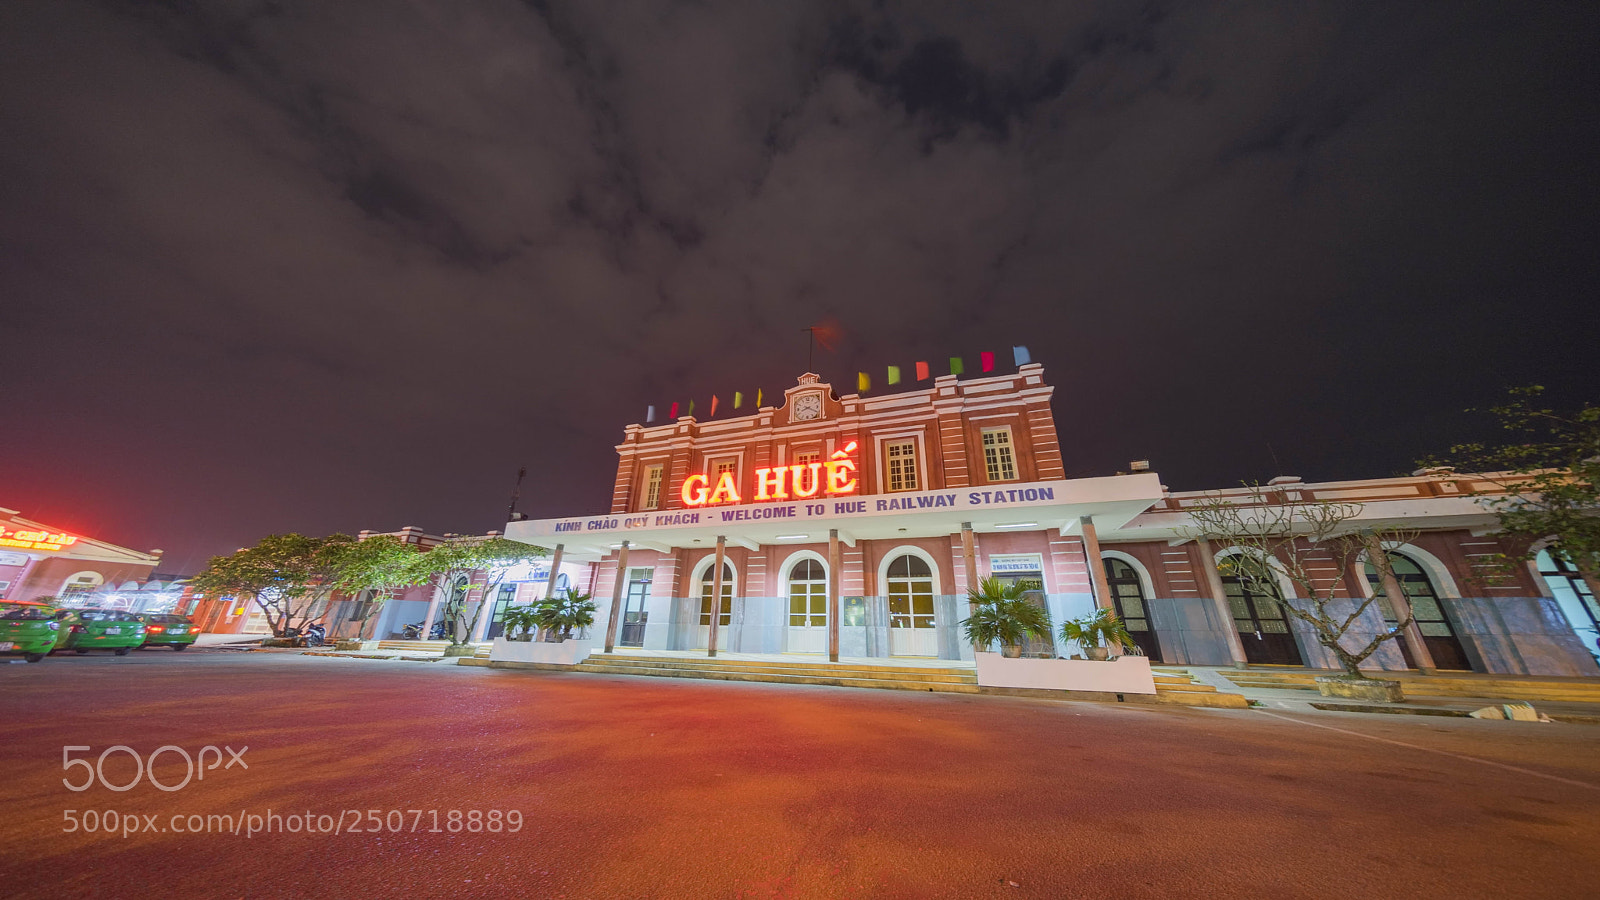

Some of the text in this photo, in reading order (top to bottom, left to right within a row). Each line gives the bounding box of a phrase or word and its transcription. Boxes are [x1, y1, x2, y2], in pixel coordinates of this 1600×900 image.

[801, 376, 816, 385] HUE
[681, 441, 858, 506] GA HUẾ
[555, 519, 582, 532] KÍNH
[587, 516, 619, 530] CHÀO
[624, 513, 649, 529] QUÝ
[655, 512, 700, 526] KHÁCH
[721, 506, 796, 522] WELCOME
[807, 504, 825, 516] TO
[834, 501, 867, 514] HUE
[876, 494, 957, 511] RAILWAY
[969, 487, 1054, 505] STATION
